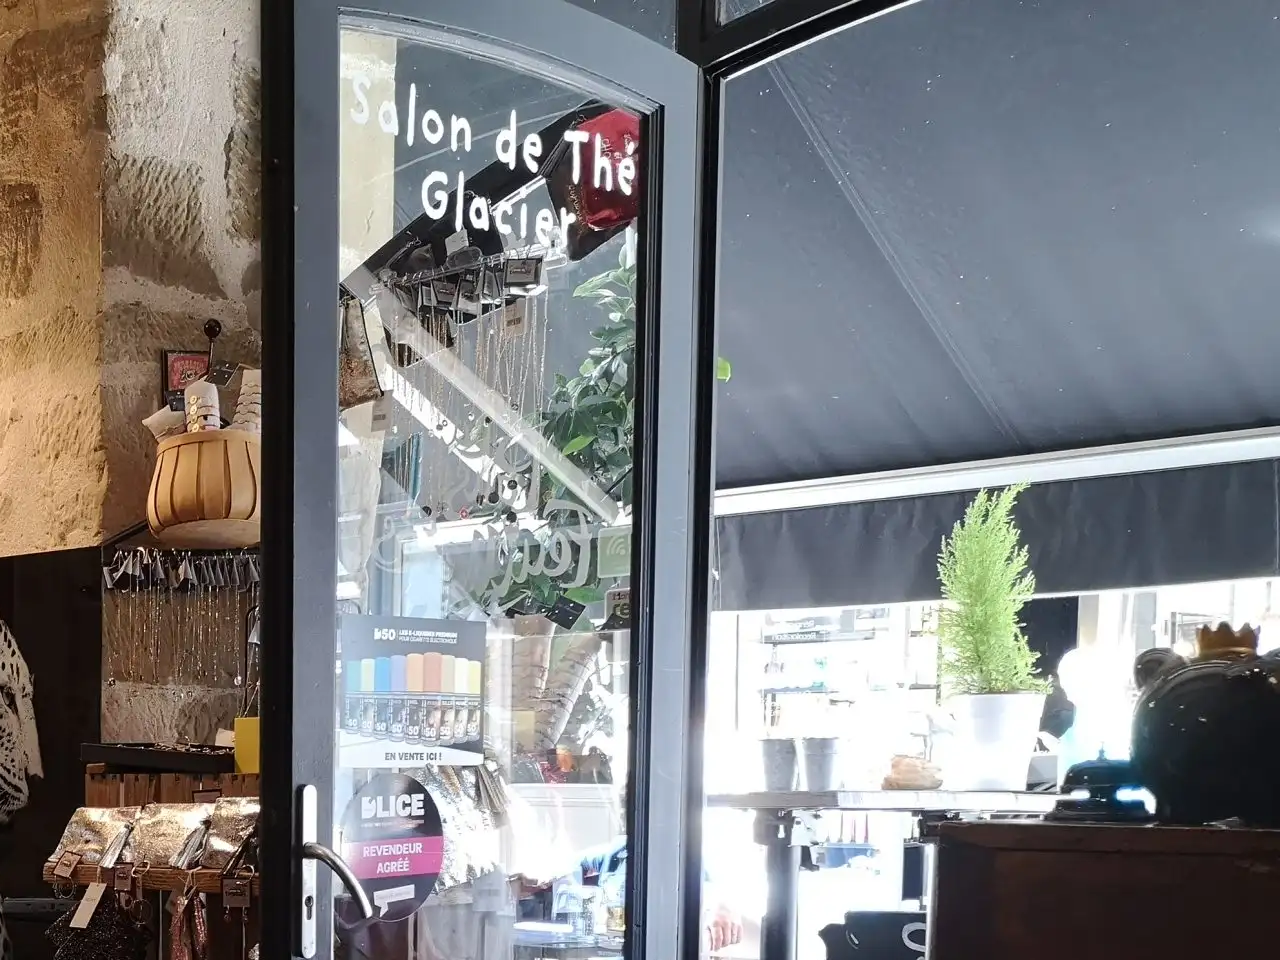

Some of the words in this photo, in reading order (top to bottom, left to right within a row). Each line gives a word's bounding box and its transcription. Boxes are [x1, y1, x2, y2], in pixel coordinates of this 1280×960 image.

[349, 74, 472, 153] Salon
[495, 109, 543, 174] de
[563, 130, 636, 196] Thé
[421, 170, 577, 250] Glacier
[385, 752, 396, 761] EN
[398, 752, 425, 761] VENTE
[426, 752, 437, 761] ICI
[363, 842, 423, 858] REVENDEUR
[376, 857, 410, 874] AGRÉÉ
